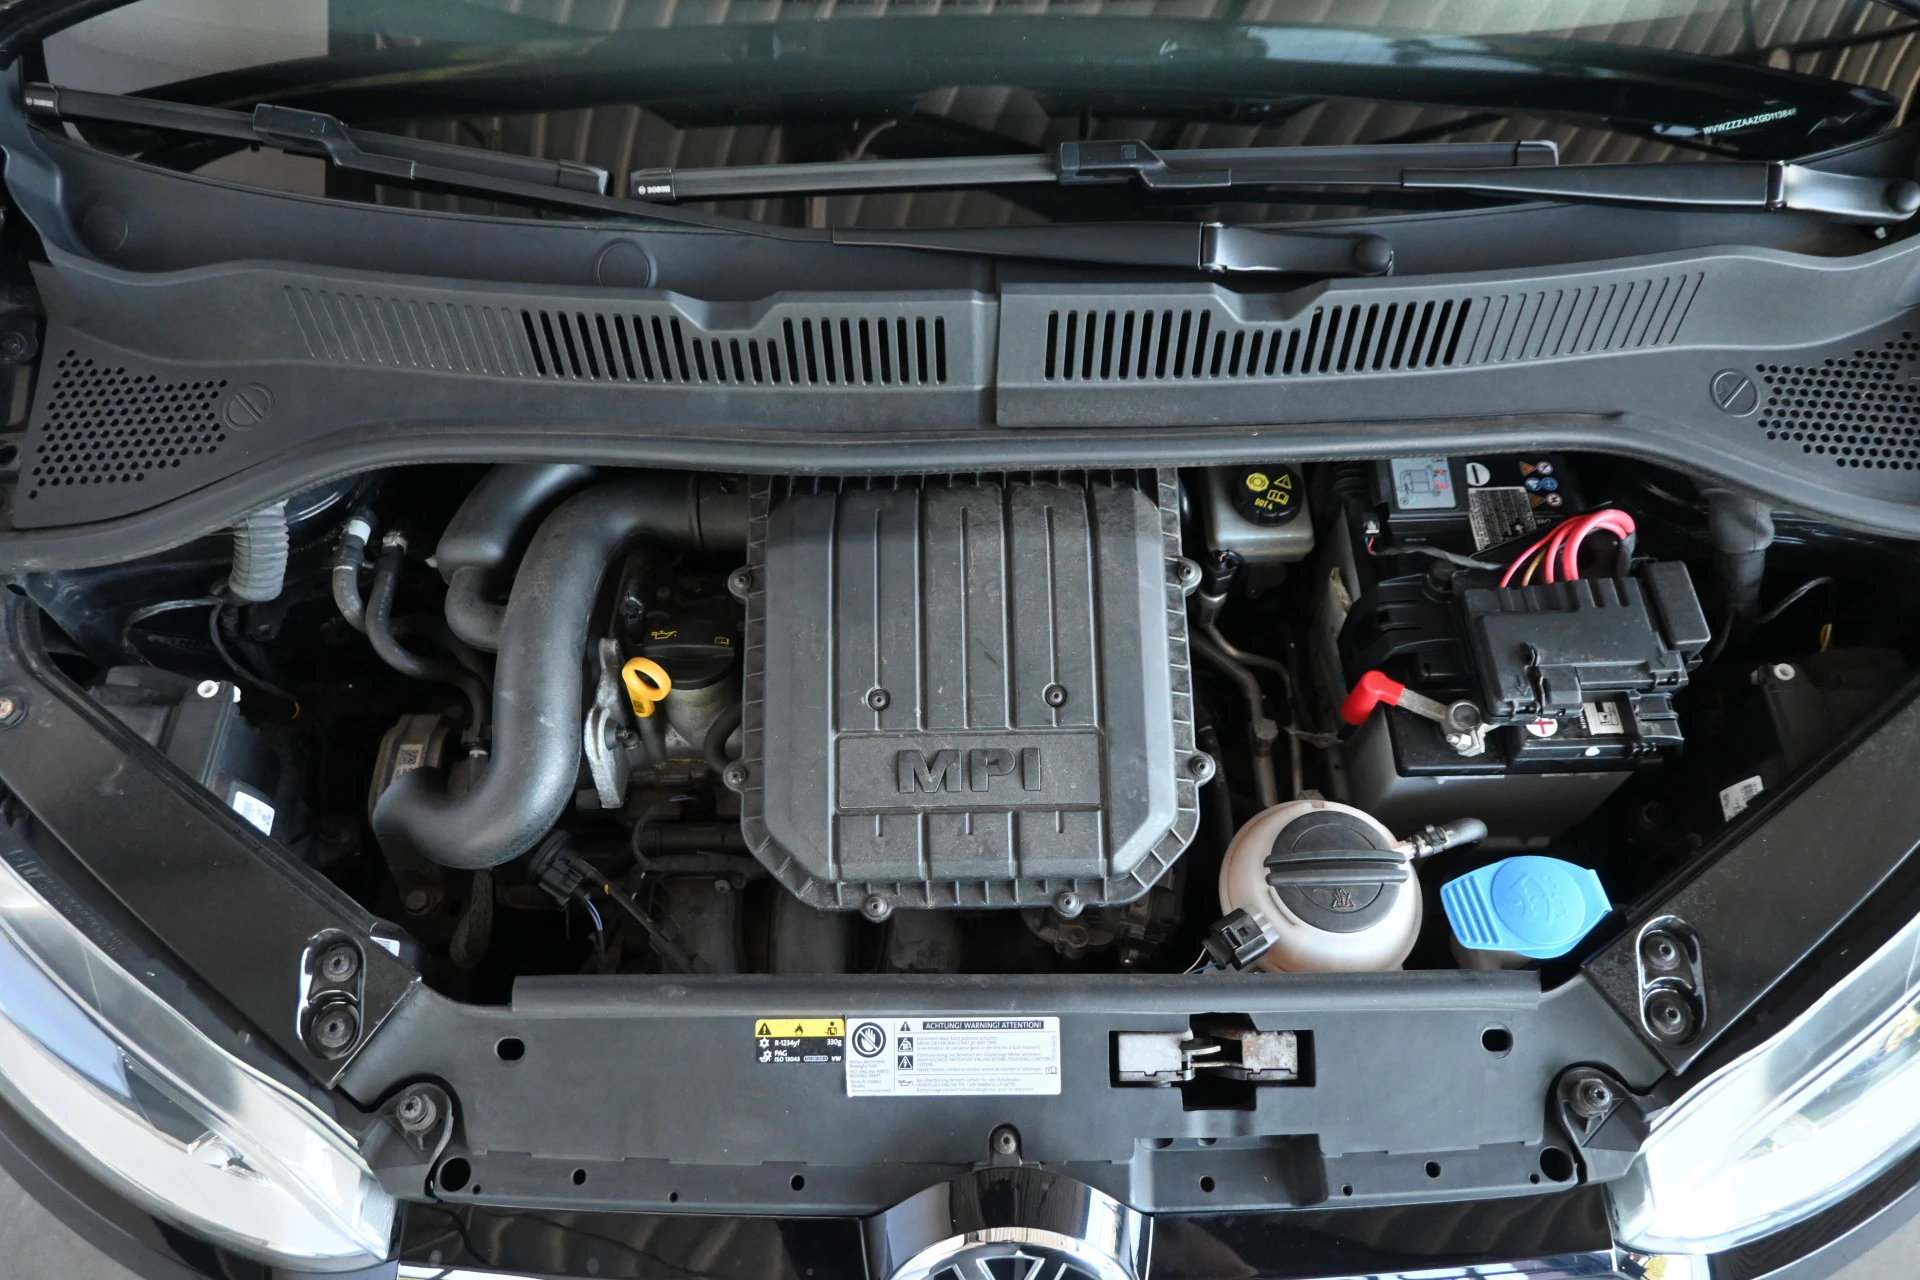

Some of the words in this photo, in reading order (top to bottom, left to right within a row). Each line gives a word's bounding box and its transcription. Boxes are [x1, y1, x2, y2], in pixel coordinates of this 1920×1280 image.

[898, 748, 1041, 793] MPI
[963, 1021, 1000, 1029] WARNING!
[1001, 1021, 1042, 1029] ATTENTION!
[774, 1039, 800, 1047] R-1234yf
[827, 1038, 842, 1047] 330g
